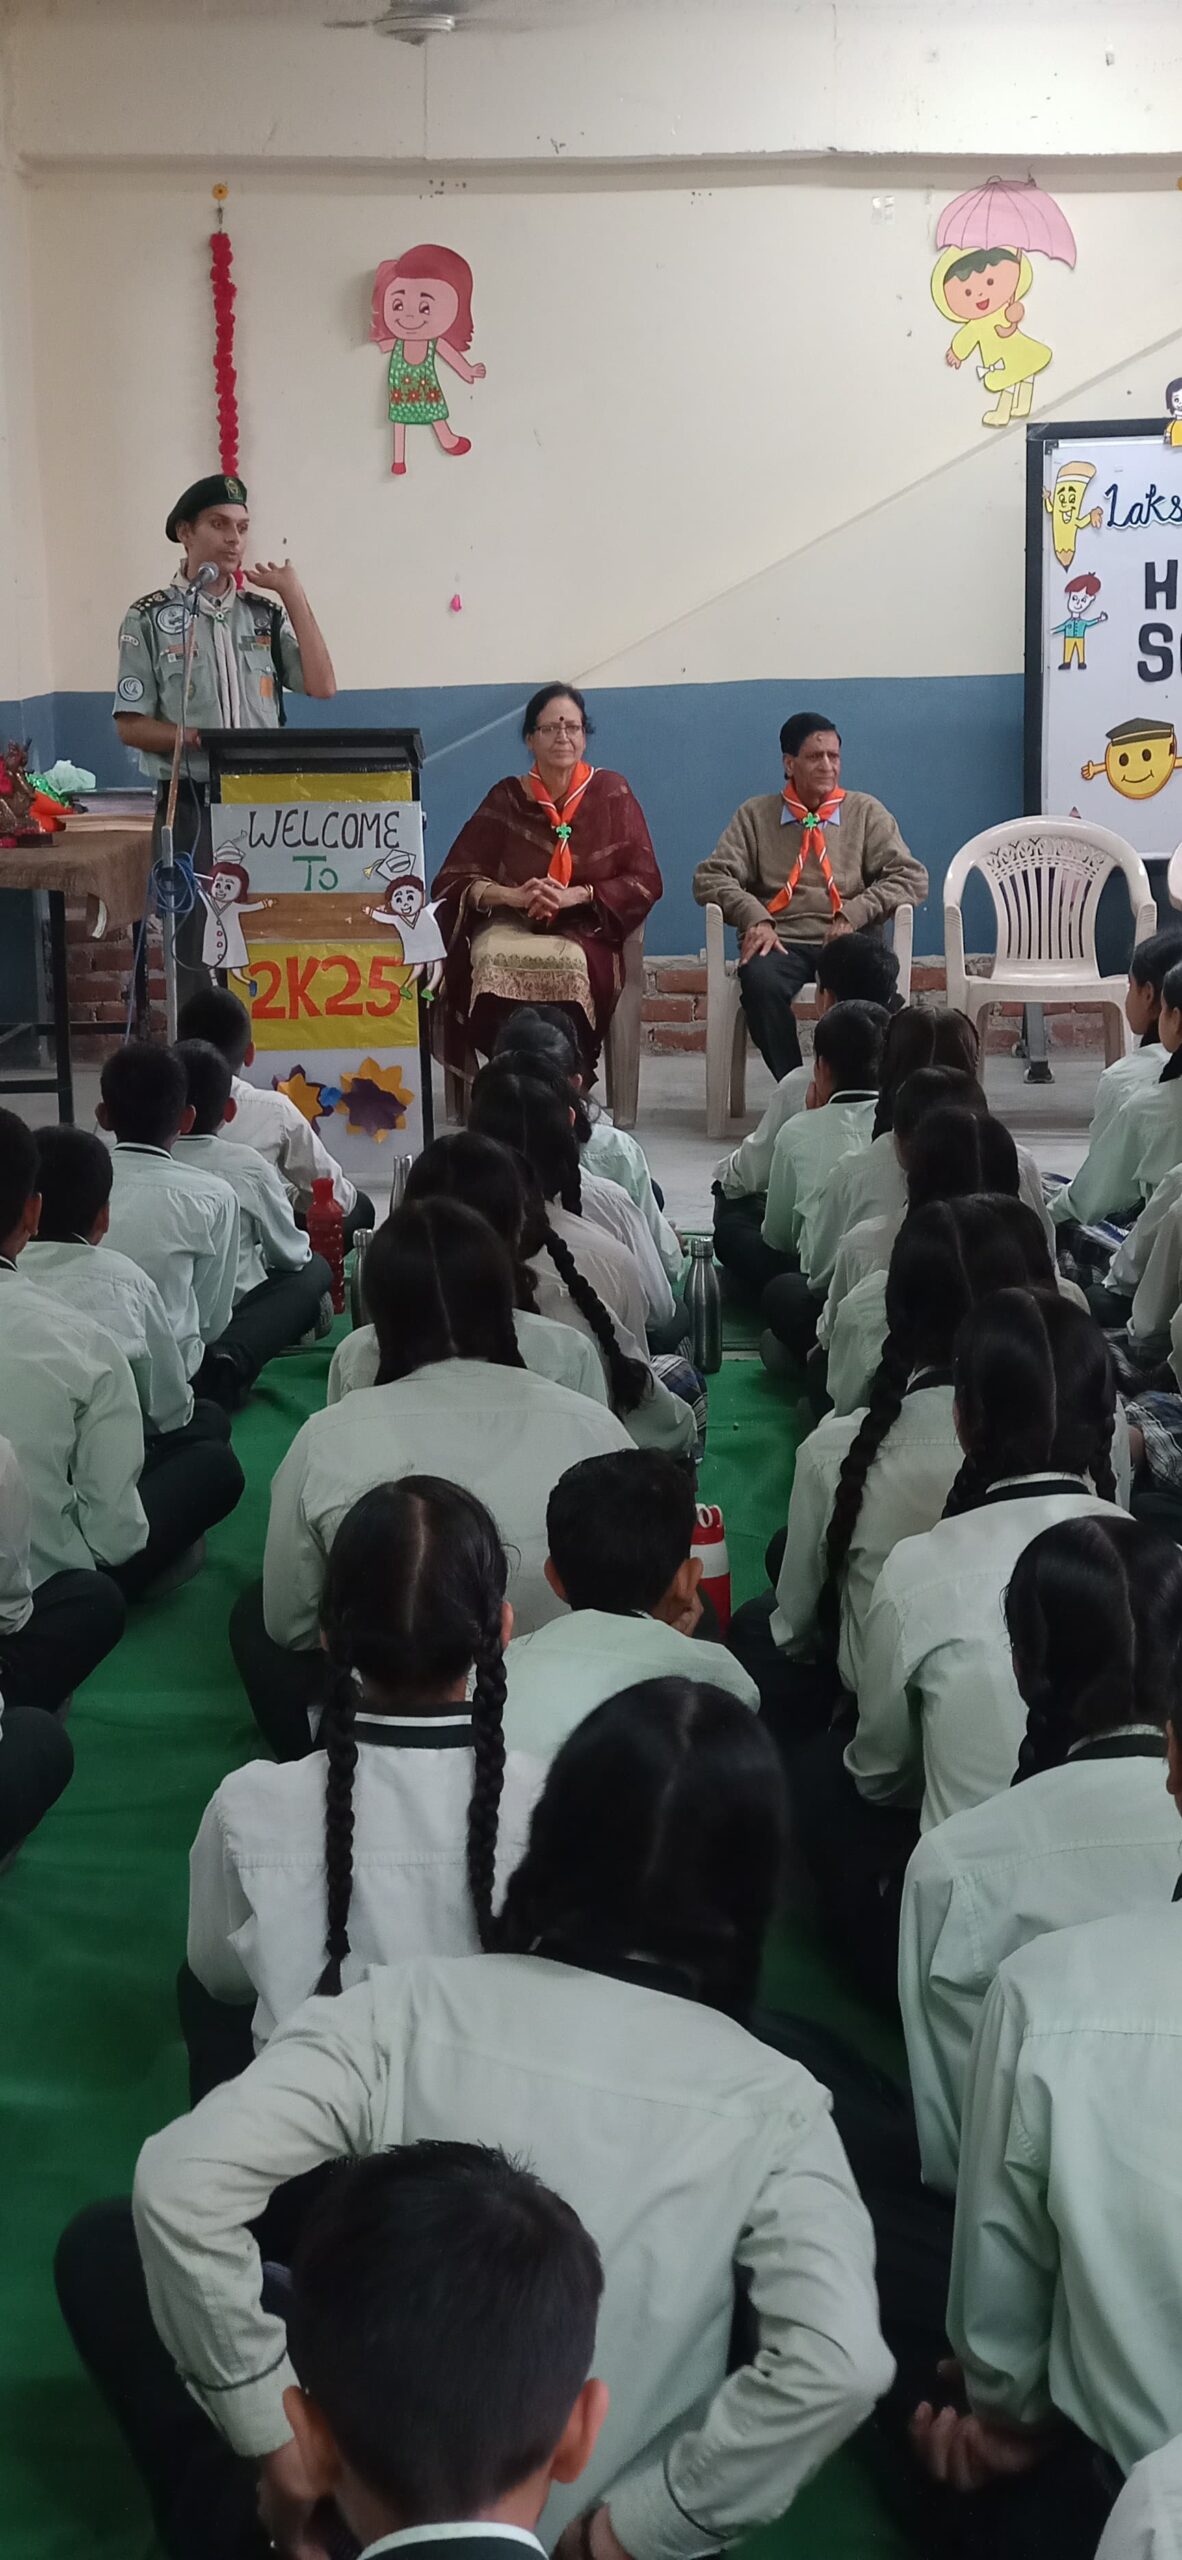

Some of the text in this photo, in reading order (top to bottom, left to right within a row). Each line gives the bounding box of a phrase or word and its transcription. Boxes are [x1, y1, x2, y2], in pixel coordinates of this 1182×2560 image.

[1137, 622, 1182, 683] S
[249, 809, 400, 848] WELCOME
[249, 955, 404, 1020] 2K25
